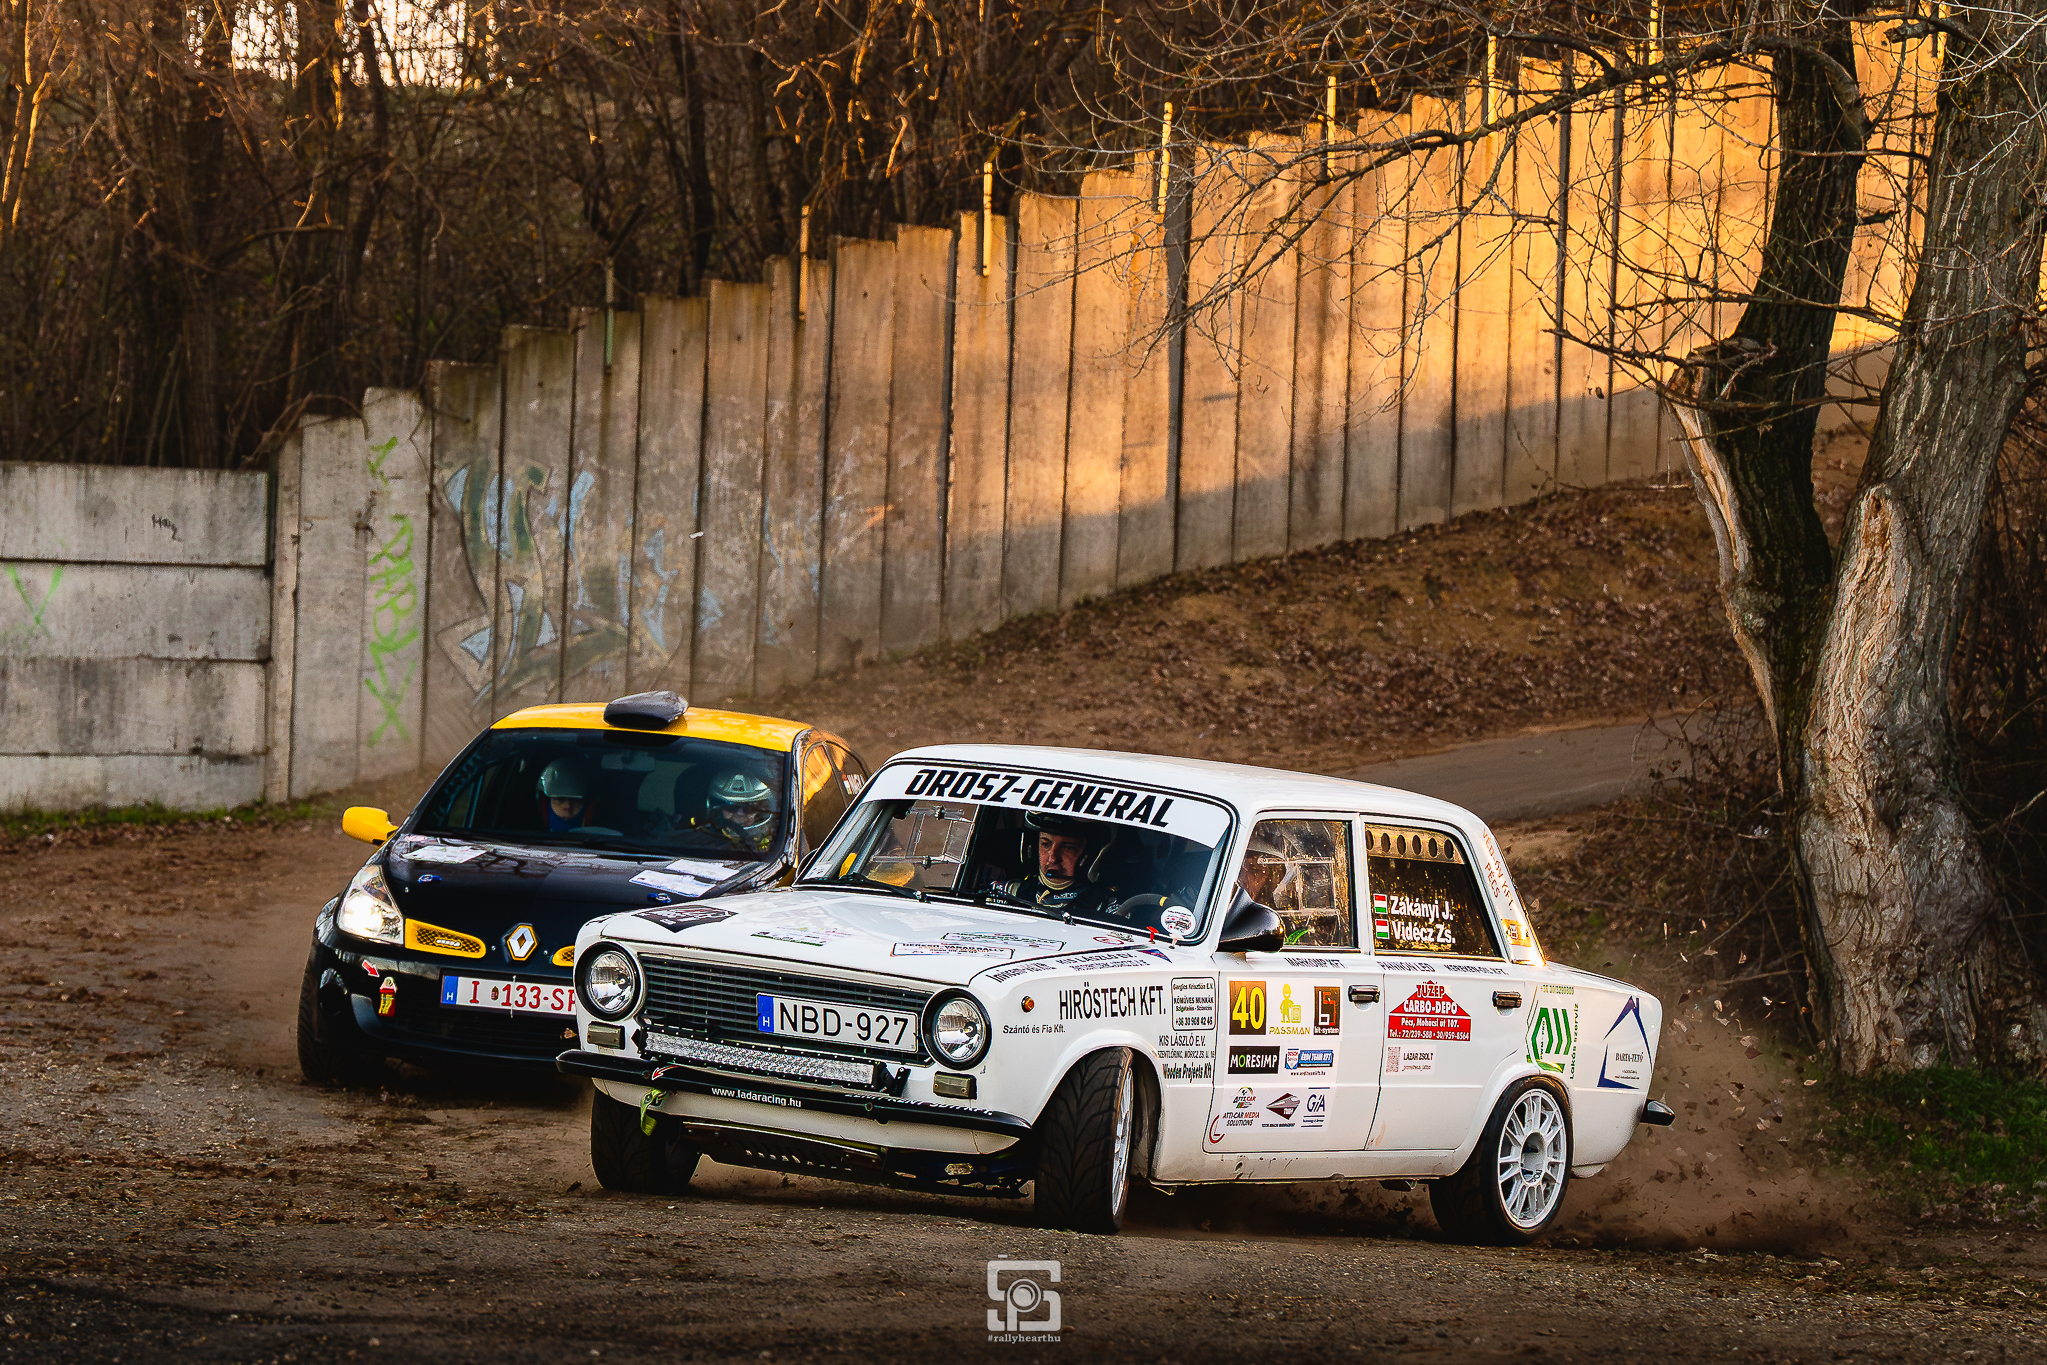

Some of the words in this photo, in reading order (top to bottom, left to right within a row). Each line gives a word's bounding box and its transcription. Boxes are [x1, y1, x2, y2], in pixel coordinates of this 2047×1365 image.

[904, 769, 1175, 828] OROSZ-GENERAL
[1390, 895, 1440, 923] Zákányi
[1441, 900, 1454, 921] J.
[1392, 920, 1435, 942] Vidécz
[1435, 923, 1457, 944] Zs.
[1416, 981, 1445, 997] TÜZÉP
[1139, 985, 1166, 1016] KFT.
[1232, 986, 1265, 1029] 40
[762, 1016, 770, 1027] H
[779, 1002, 909, 1045] NBD-927
[1002, 1024, 1030, 1034] Szántó
[1031, 1025, 1040, 1034] és
[1041, 1025, 1053, 1034] Fia
[1053, 1024, 1066, 1034] Kft.
[1269, 1026, 1311, 1035] PASSMAN
[1401, 1017, 1415, 1027] Pécs,
[1159, 1035, 1169, 1047] KIS
[1170, 1033, 1194, 1047] LÁSZLÓ
[1230, 1054, 1278, 1068] MORESIMP
[1162, 1063, 1182, 1080] Wooden
[1182, 1062, 1203, 1083] Projects
[711, 1086, 802, 1108] www.ladaracing.hu
